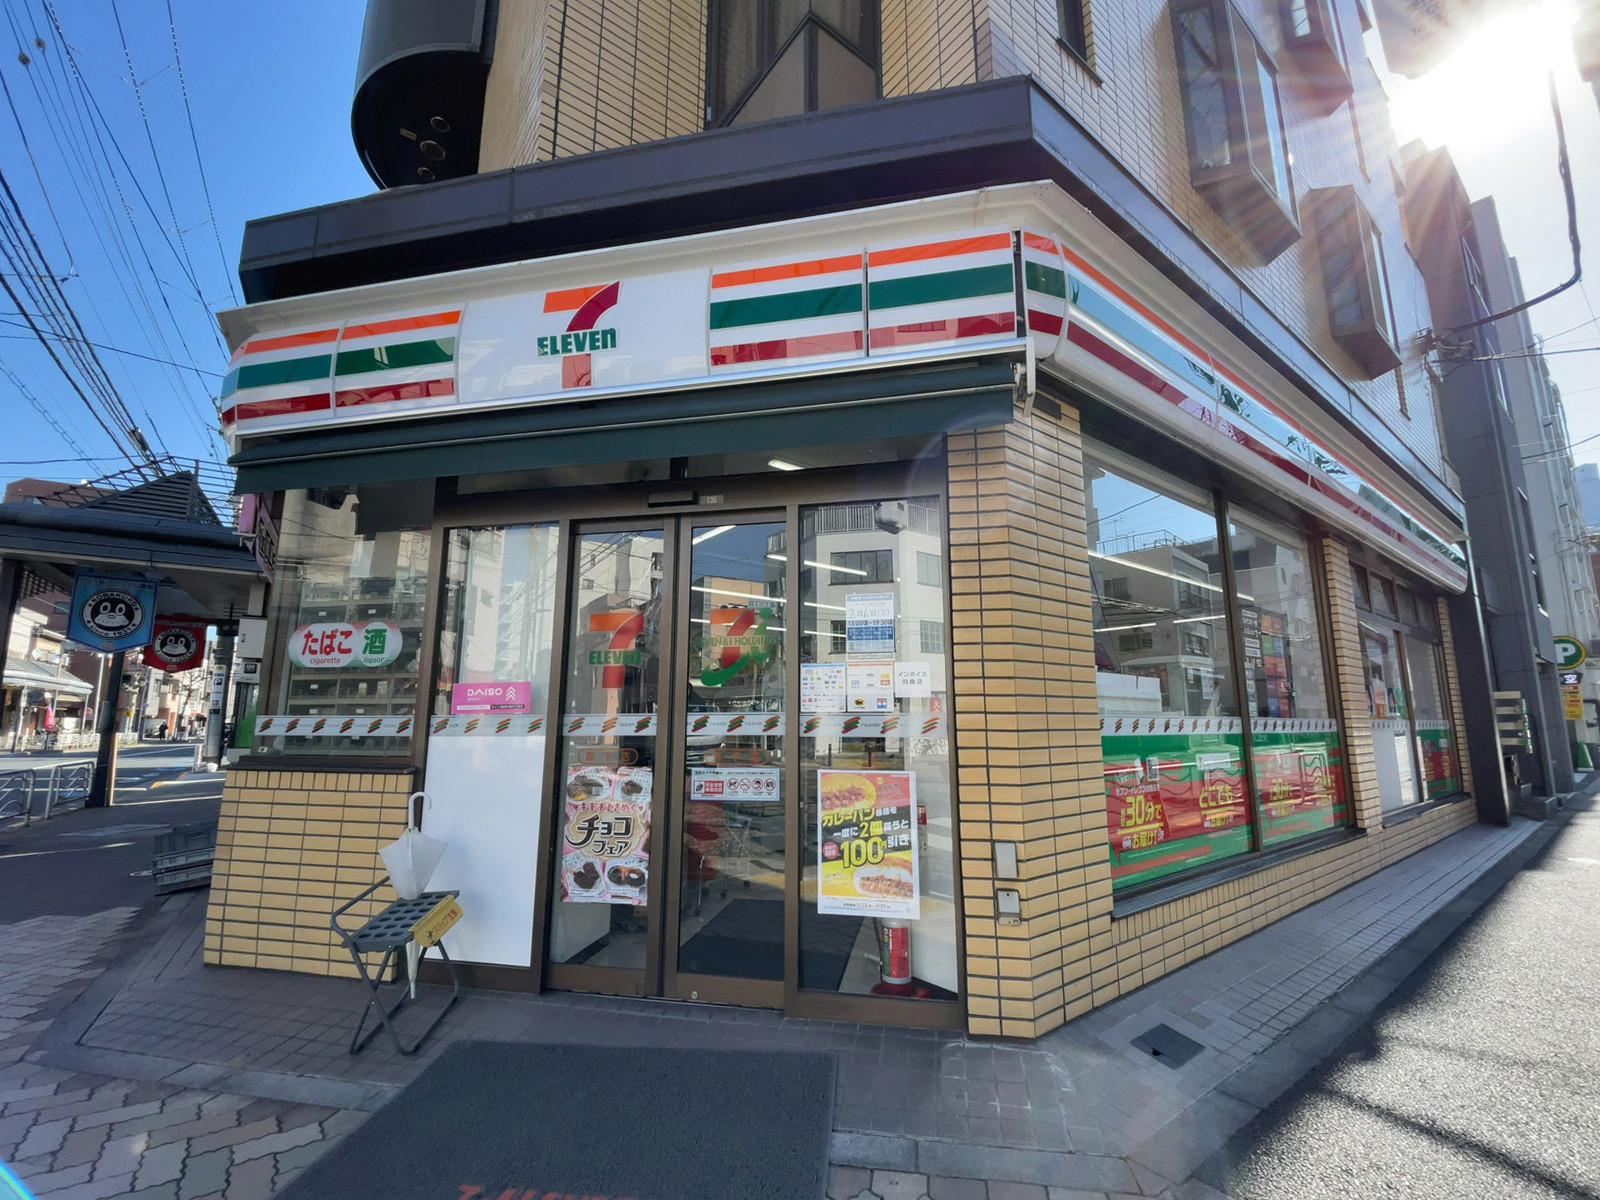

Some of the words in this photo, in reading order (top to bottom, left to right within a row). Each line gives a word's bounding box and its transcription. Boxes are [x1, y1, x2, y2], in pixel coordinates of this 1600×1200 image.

[543, 281, 620, 388] 7
[90, 591, 138, 608] NORAKURO
[89, 624, 111, 637] since
[302, 628, 353, 655] たばこ
[362, 628, 388, 655] 酒
[310, 657, 341, 665] cigarette
[363, 656, 385, 665] liquor
[1554, 643, 1576, 664] P
[467, 688, 503, 697] DAISO
[565, 814, 632, 847] チョコ
[592, 840, 629, 856] フェア
